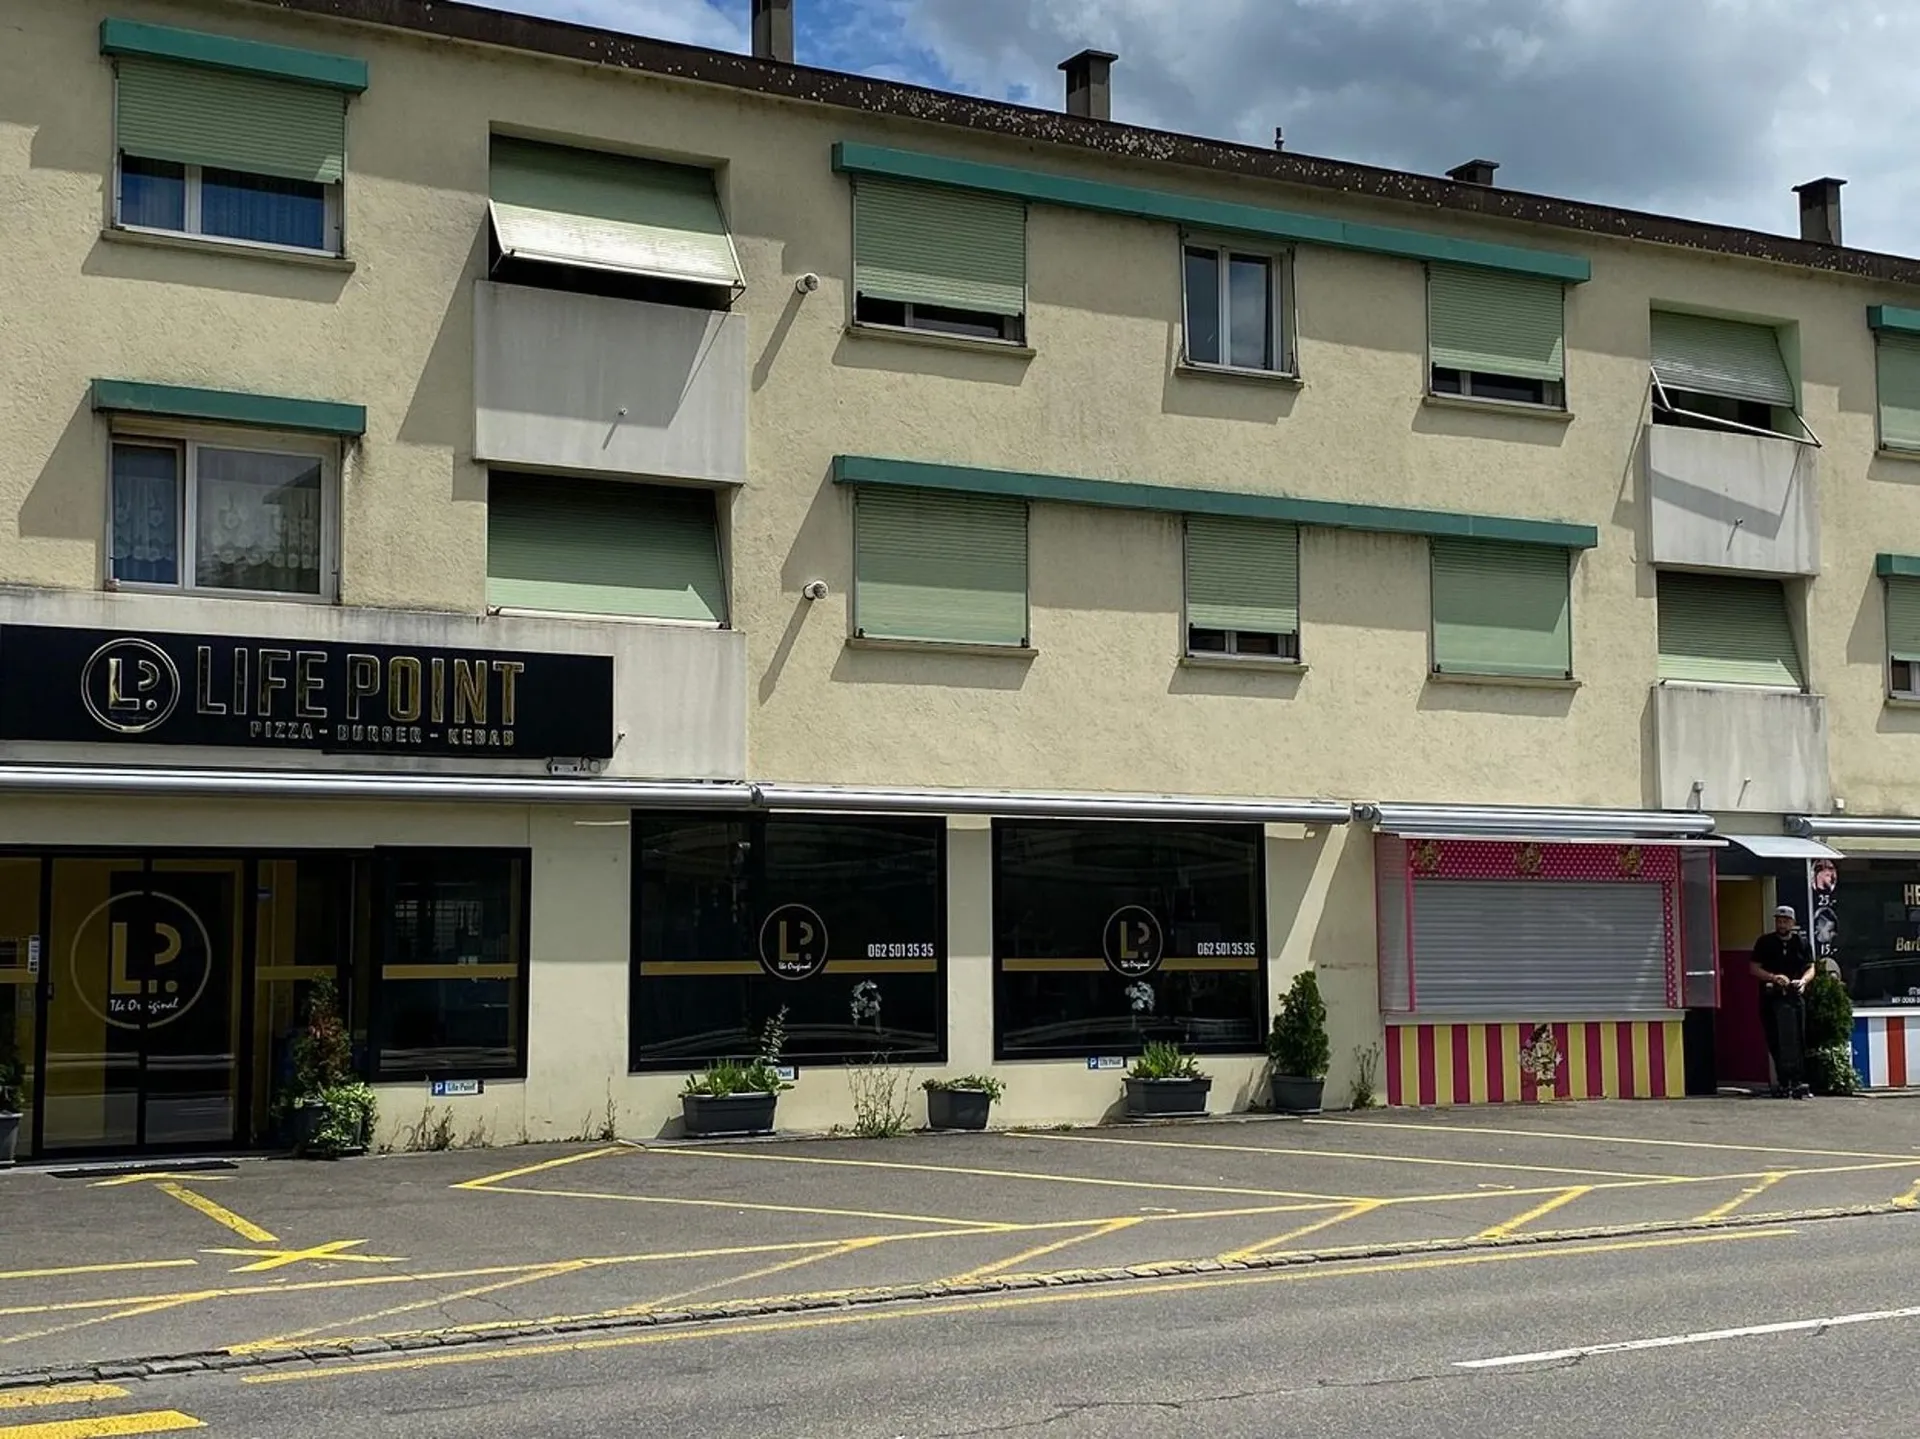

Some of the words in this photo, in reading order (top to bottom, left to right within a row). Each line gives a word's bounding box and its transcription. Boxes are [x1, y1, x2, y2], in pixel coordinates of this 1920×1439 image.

[197, 645, 328, 719] LIFE
[346, 653, 525, 726] POINT
[249, 720, 314, 740] PIZZA
[337, 724, 422, 744] BURGER
[447, 728, 515, 746] KEBAB
[867, 943, 887, 958] 062
[1197, 942, 1214, 956] 062
[110, 999, 126, 1012] The
[1090, 1057, 1097, 1068] P
[434, 1082, 443, 1094] P
